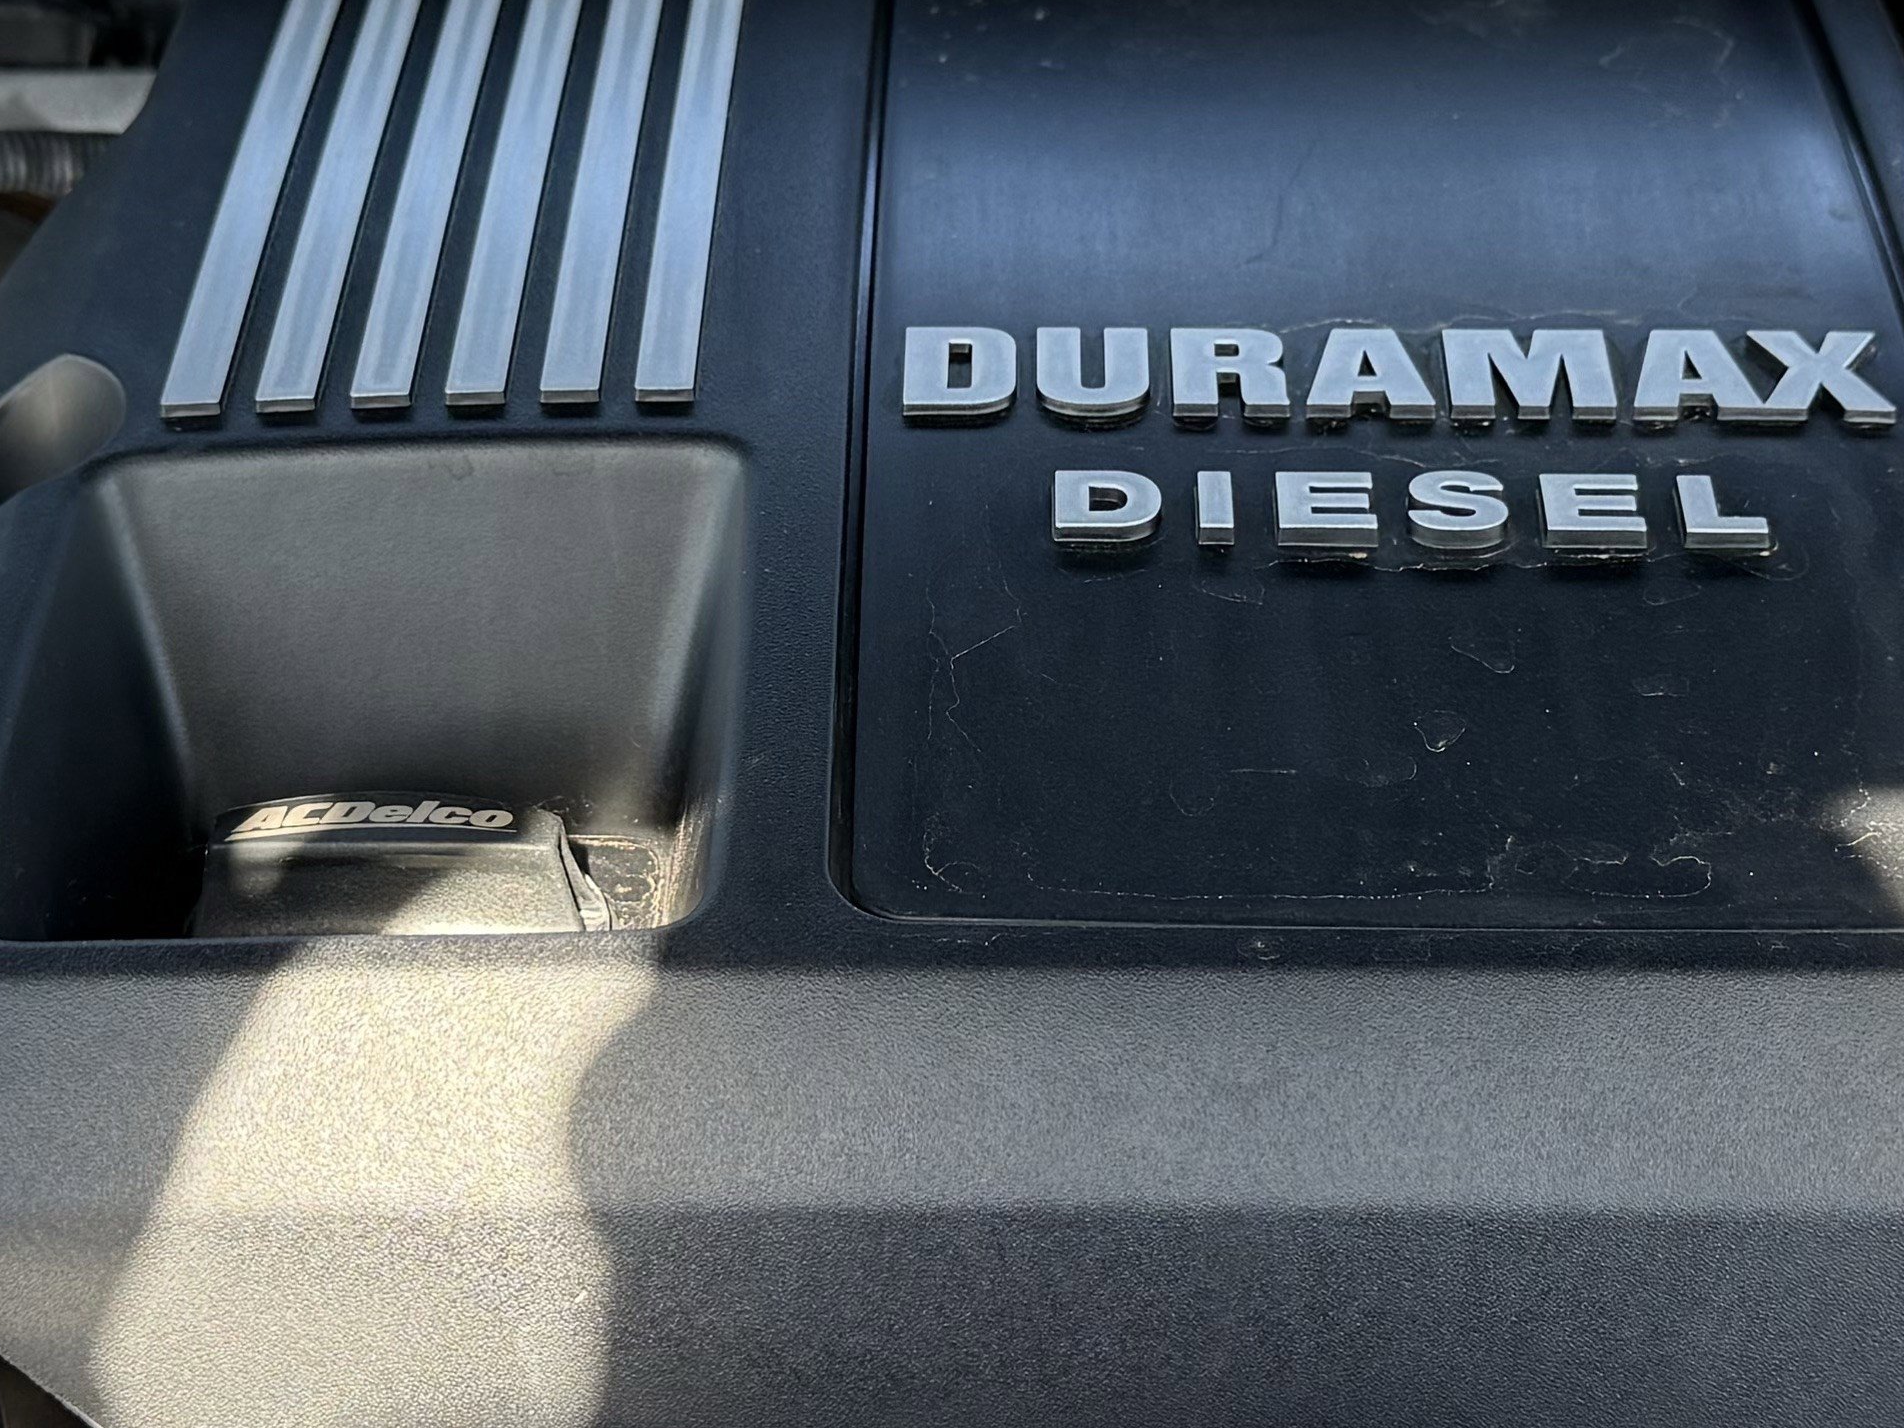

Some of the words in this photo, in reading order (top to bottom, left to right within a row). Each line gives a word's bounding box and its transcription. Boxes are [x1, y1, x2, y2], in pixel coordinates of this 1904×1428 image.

[902, 326, 1896, 425] DURAMAX
[1053, 469, 1772, 550] DIESEL
[231, 800, 514, 833] ACDelco
